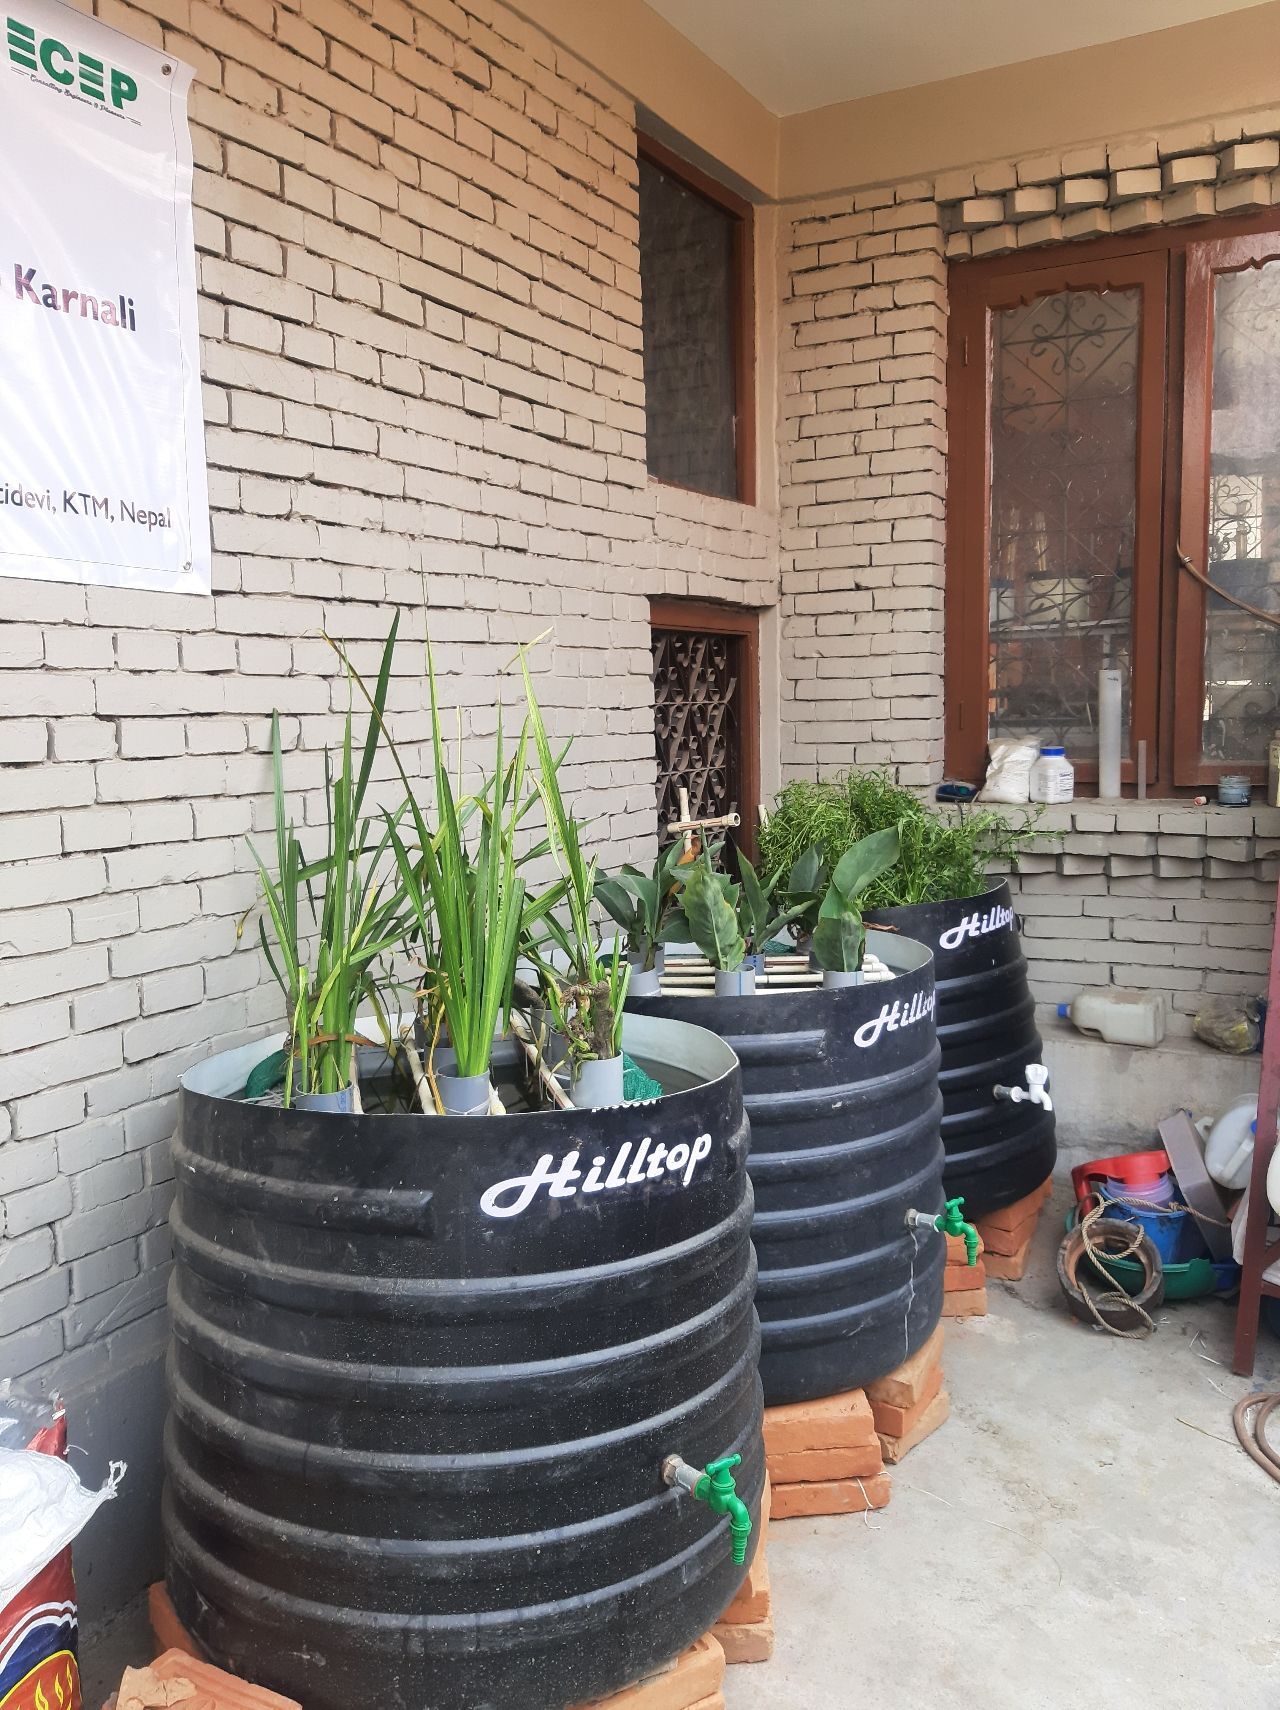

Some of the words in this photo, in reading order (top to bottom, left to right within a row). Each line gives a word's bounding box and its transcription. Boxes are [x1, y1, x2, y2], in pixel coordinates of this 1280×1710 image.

[7, 17, 138, 110] ECEP
[14, 263, 136, 331] Karnali
[63, 489, 115, 523] KTM,
[120, 499, 171, 532] Nepal
[939, 904, 1014, 950] Hilltop
[480, 1133, 712, 1218] Hilltop
